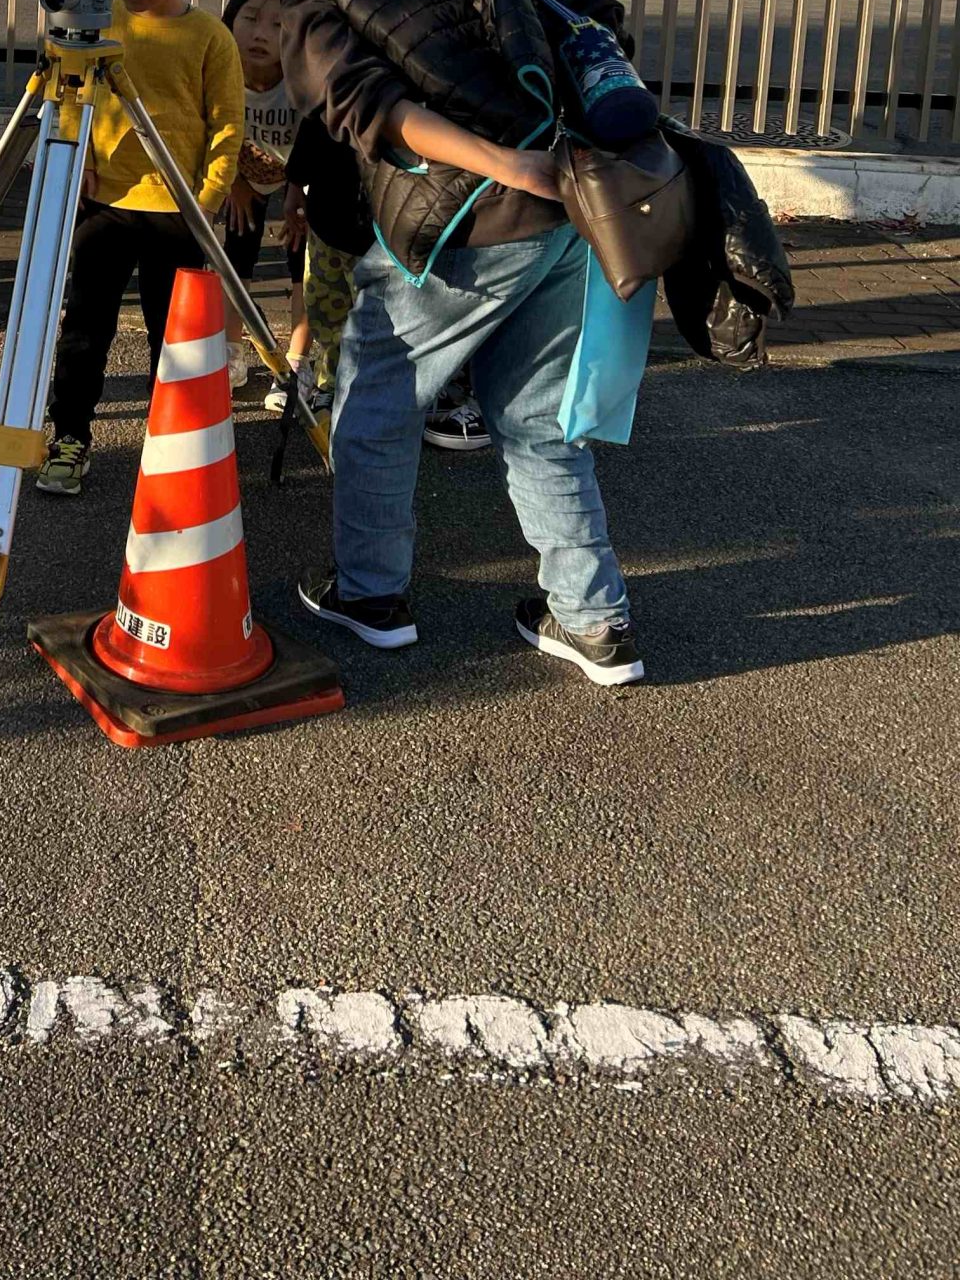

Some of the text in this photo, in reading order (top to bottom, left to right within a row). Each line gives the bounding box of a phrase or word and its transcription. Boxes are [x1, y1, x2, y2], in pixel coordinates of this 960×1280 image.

[245, 124, 292, 146] TERS
[117, 604, 168, 647] 山建設
